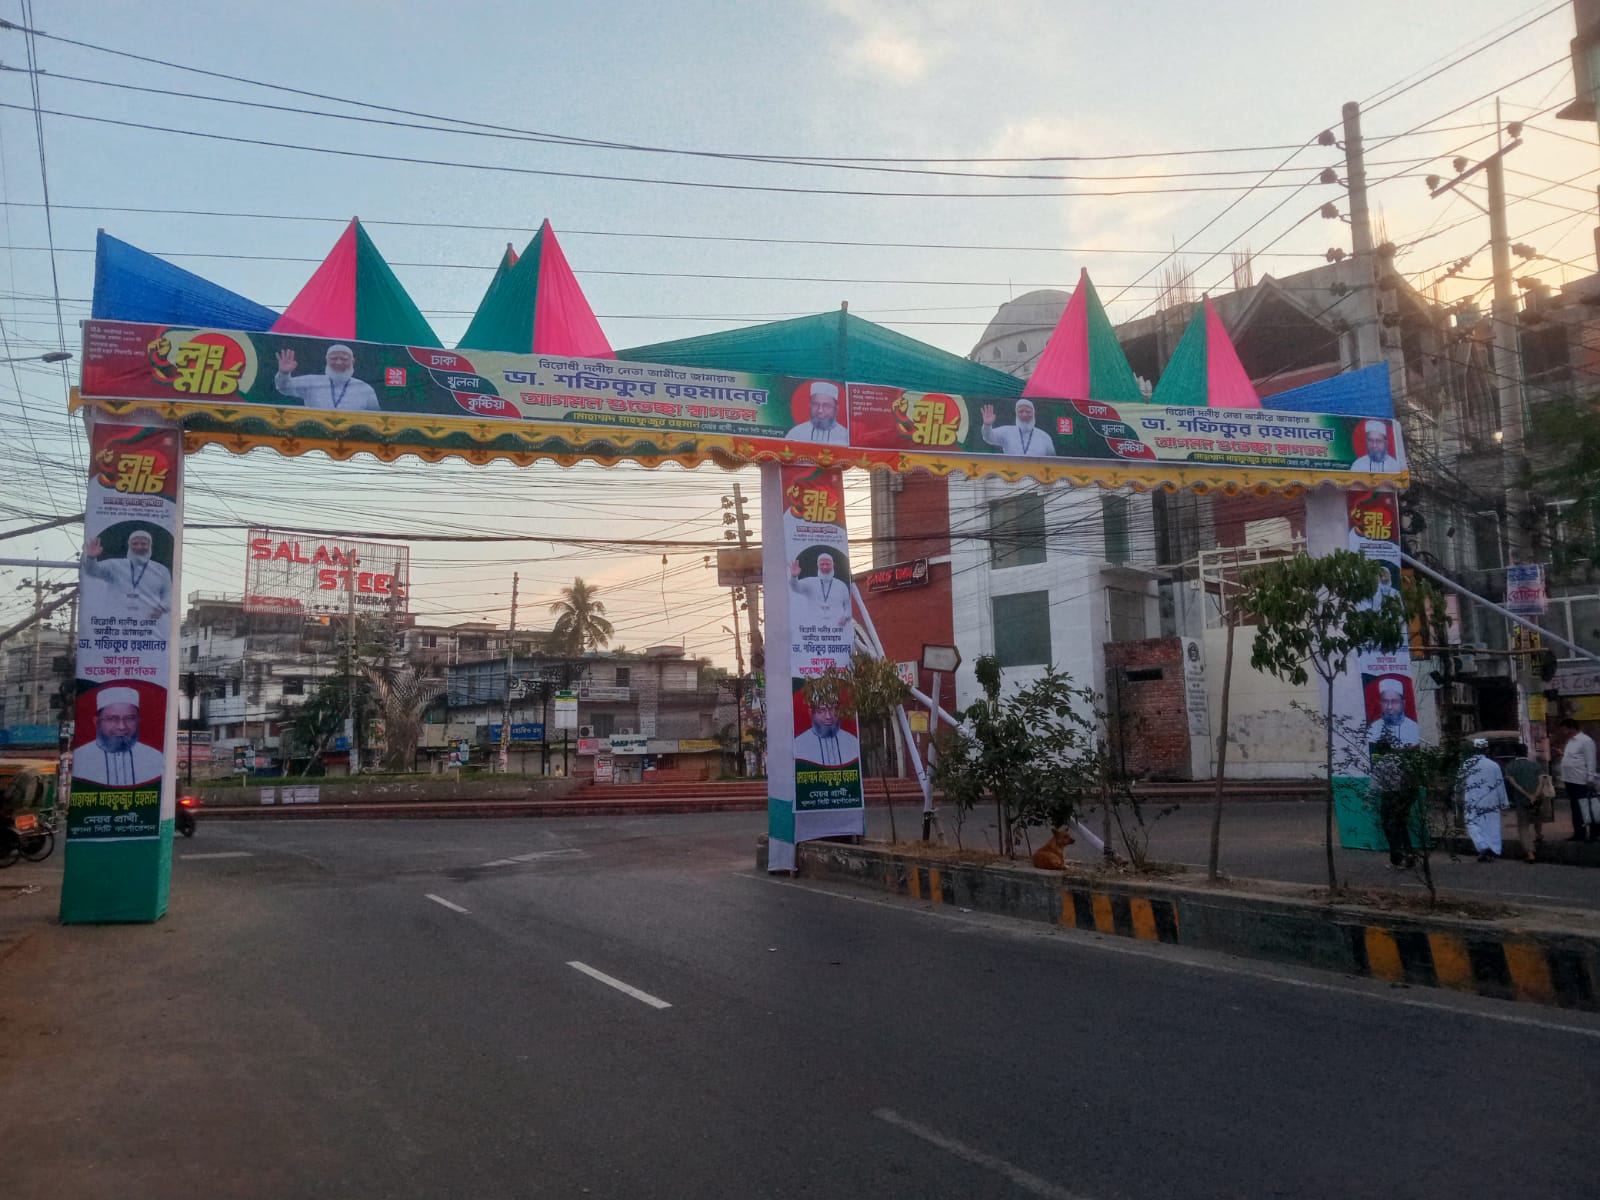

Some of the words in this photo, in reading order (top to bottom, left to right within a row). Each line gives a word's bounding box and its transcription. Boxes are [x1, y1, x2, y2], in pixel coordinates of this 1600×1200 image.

[431, 355, 457, 366] ঢাকা
[173, 362, 244, 395] মার্চ
[538, 359, 579, 371] বিরোধী
[584, 362, 614, 374] দলীয়
[618, 367, 643, 377] নেতা
[647, 368, 686, 380] আমীরে
[690, 373, 736, 383] জামায়াত
[447, 376, 479, 389] খুলনা
[503, 370, 544, 386] ডা.
[554, 371, 656, 398] শফিকুর
[664, 383, 769, 405] রহমানের
[468, 396, 505, 410] কুষ্টিয়া
[520, 392, 603, 410] আগমন
[608, 398, 682, 417] শুভেচ্ছা
[686, 404, 758, 422] স্বাগতম
[1088, 406, 1107, 416] ঢাকা
[1166, 407, 1195, 416] বিরোধী
[1198, 408, 1221, 419] দলীয়
[1223, 411, 1242, 419] নেতা
[1244, 411, 1273, 422] আমীরে
[912, 416, 960, 445] মার্চ
[1101, 424, 1125, 435] খুলনা
[1140, 418, 1171, 431] ডা.
[1177, 417, 1251, 439] শফিকুর
[1257, 425, 1335, 441] রহমানের
[1117, 441, 1145, 454] কুষ্টিয়া
[1154, 437, 1214, 450] আগমন
[1216, 440, 1272, 455] শুভেচ্ছা
[1274, 444, 1329, 457] স্বাগতম
[115, 469, 168, 493] মার্চ
[803, 501, 839, 522] মার্চ
[251, 538, 360, 567] SALAM
[319, 569, 405, 595] STEEL
[91, 616, 116, 626] বিরোধী
[79, 639, 92, 649] ডা.
[94, 636, 128, 653] শফিকুর
[130, 640, 166, 652] রহমানের
[103, 656, 140, 665] আগমন
[84, 666, 120, 677] শুভেচ্ছা
[124, 666, 157, 676] স্বাগতম
[134, 791, 158, 807] রহমান
[83, 815, 112, 824] মেয়র
